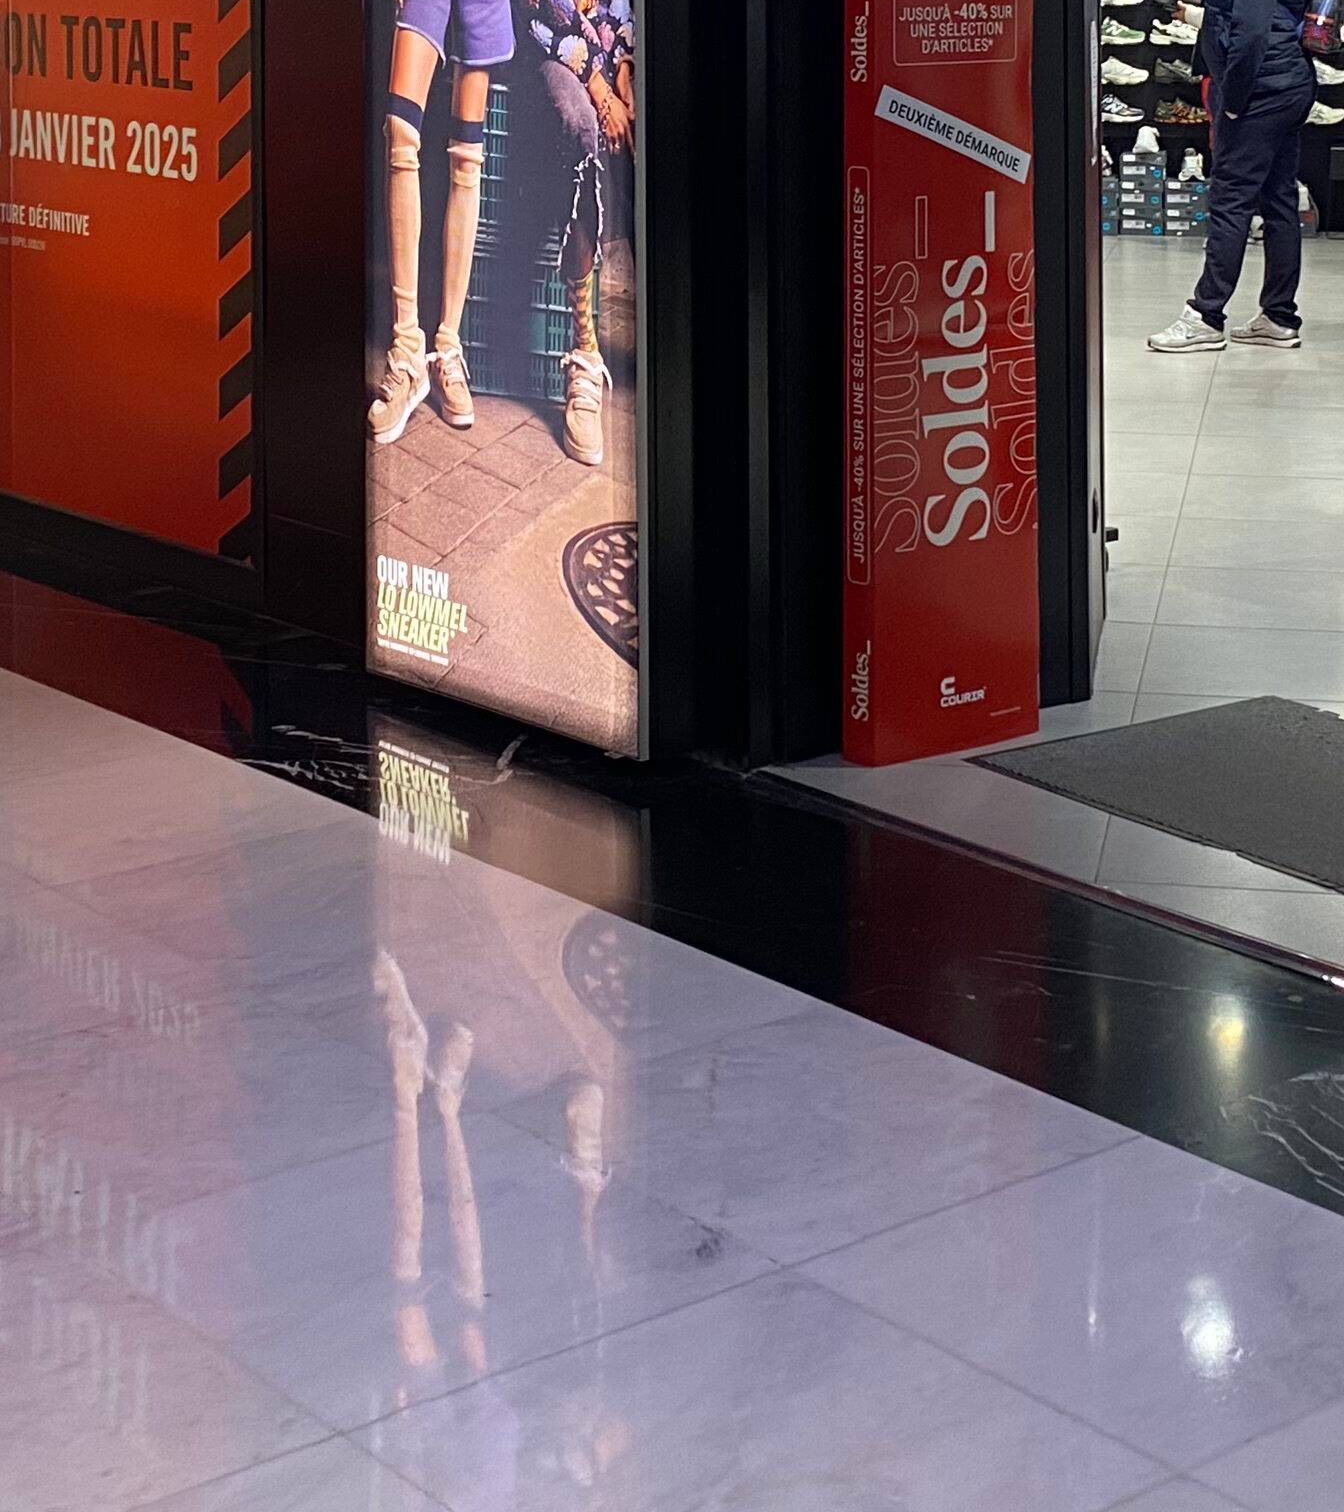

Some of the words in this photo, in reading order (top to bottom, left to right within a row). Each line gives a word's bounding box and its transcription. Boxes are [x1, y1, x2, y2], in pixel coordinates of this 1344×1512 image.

[898, 3, 953, 22] JUSQU'À
[954, 2, 989, 19] -40%
[990, 5, 1013, 20] SUR
[910, 23, 936, 38] UNE
[938, 18, 1003, 37] SÉLECTION
[60, 15, 194, 91] TOTALE
[9, 108, 116, 171] JANVIER
[126, 120, 199, 182] 2025
[888, 99, 956, 141] DEUXIÈME
[955, 122, 1020, 173] DÉMARQUE
[28, 203, 90, 236] DÉFINITIVE
[852, 289, 866, 379] SÉLECTION
[852, 381, 865, 412] UNE
[852, 416, 865, 452] SUR
[852, 494, 865, 563] JUSQU'À
[376, 555, 407, 588] OUR
[411, 563, 449, 600] NEW
[376, 583, 398, 613] LO
[399, 587, 468, 633] LOWMEL
